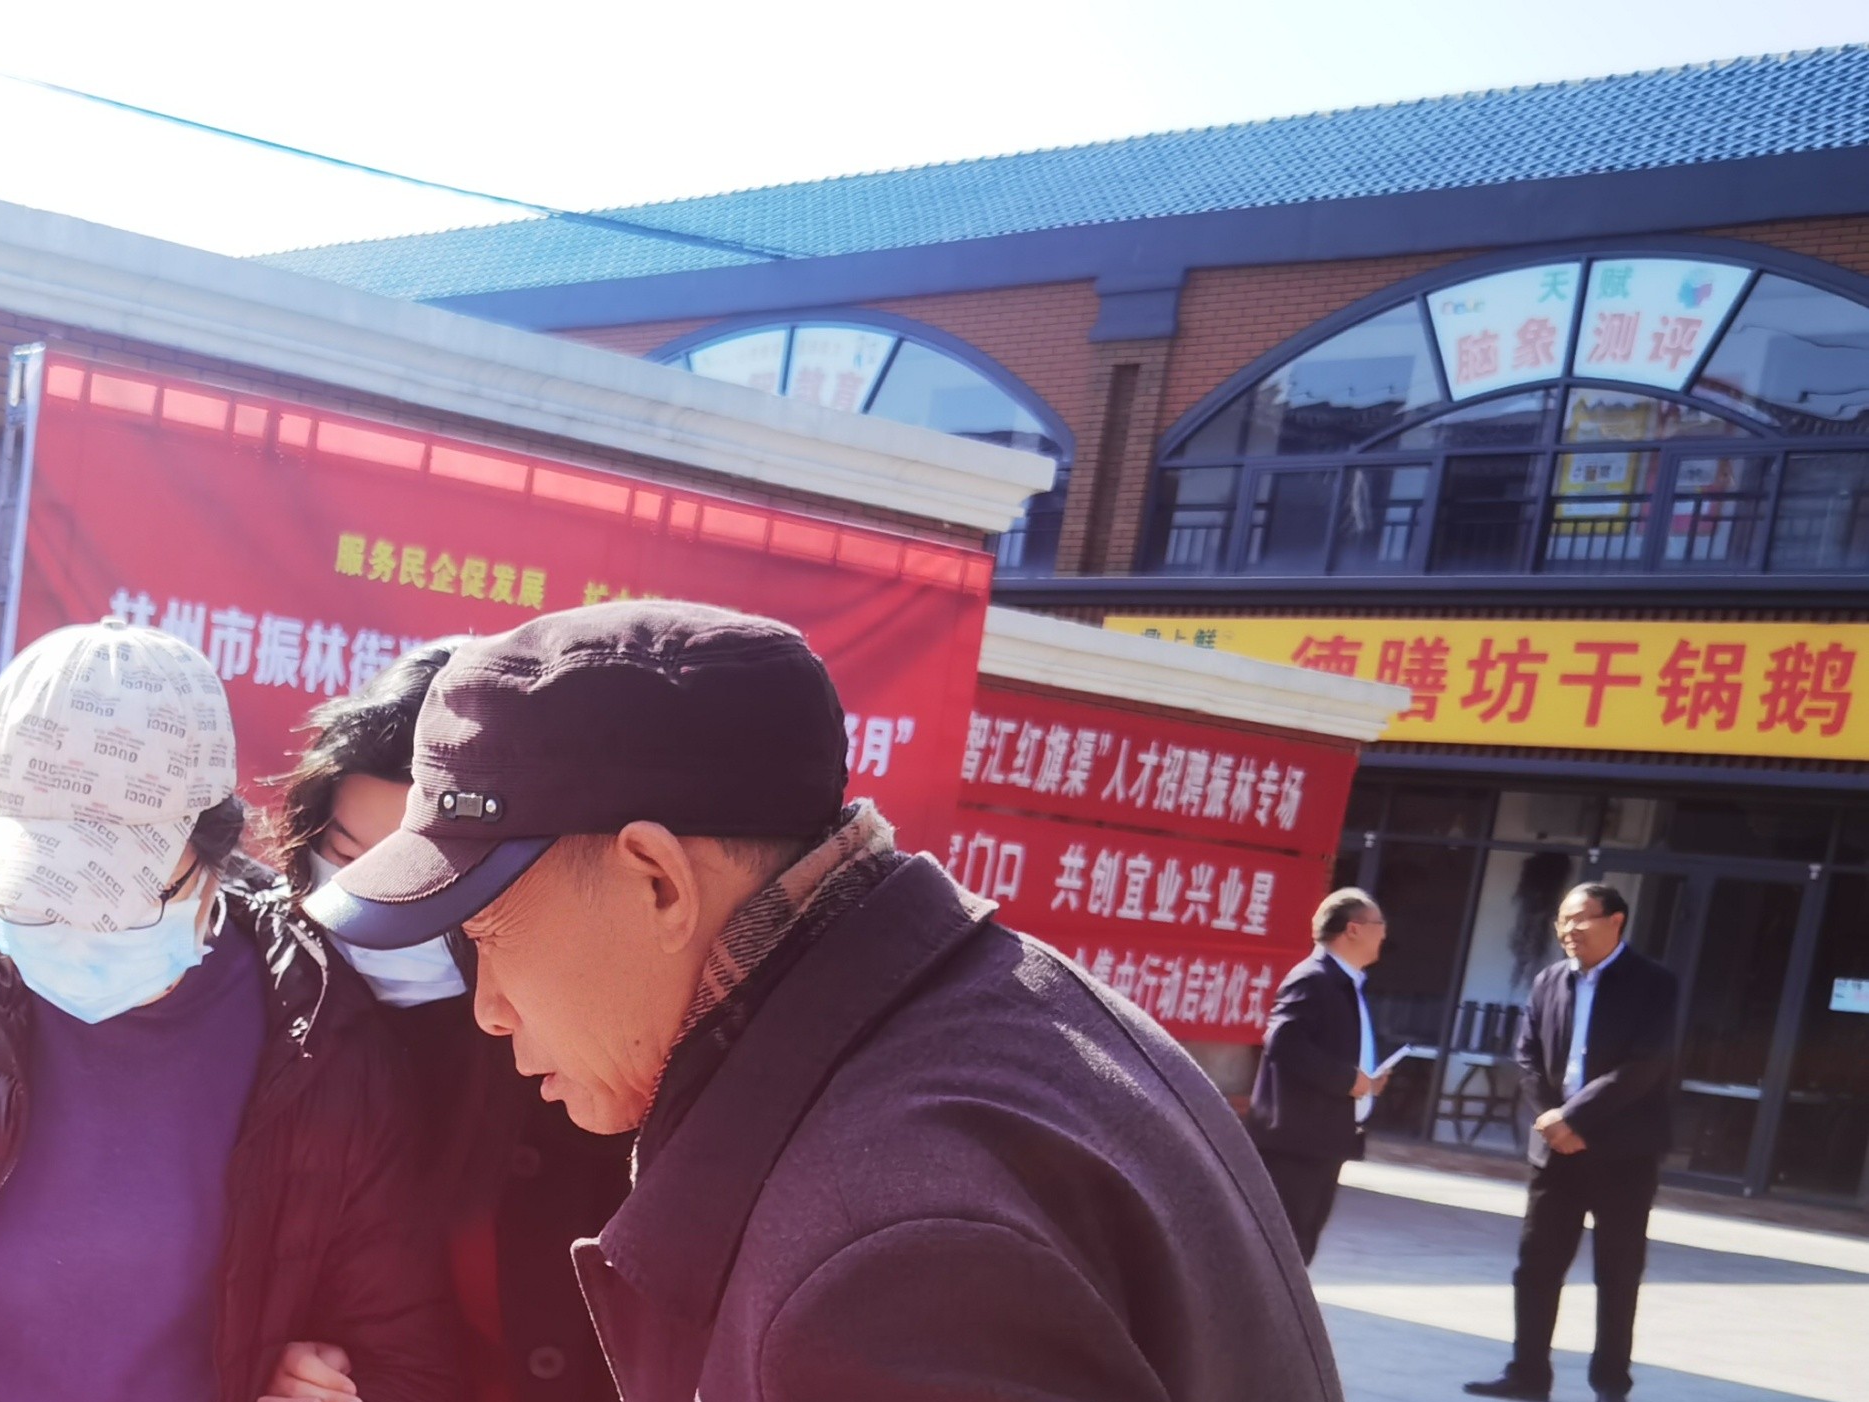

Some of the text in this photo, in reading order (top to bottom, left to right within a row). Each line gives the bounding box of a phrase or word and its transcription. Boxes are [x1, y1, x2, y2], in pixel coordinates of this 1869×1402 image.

[1539, 267, 1633, 302] 天赋
[1455, 310, 1704, 385] 脑象测评
[335, 532, 547, 610] 服务民企促发展
[94, 742, 138, 763] GUCCI
[36, 864, 79, 895] GUCCI
[87, 859, 126, 897] GUCCI
